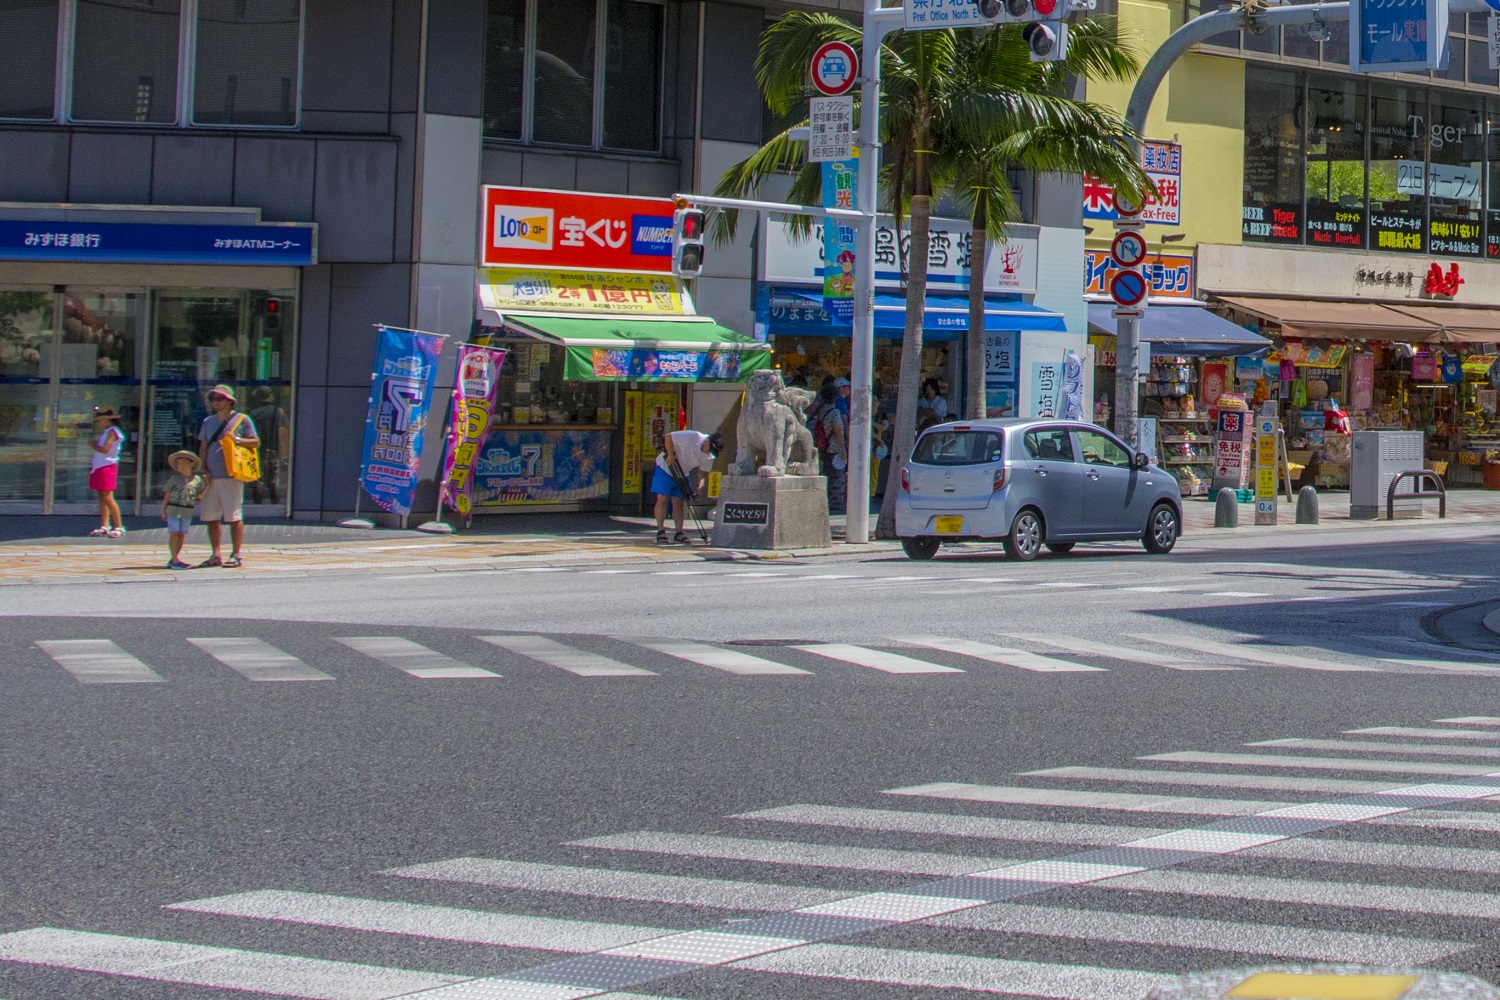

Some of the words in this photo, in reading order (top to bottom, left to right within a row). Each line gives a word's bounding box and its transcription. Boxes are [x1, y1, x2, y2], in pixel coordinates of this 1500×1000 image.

[913, 11, 927, 22] Pref.
[930, 10, 949, 21] Office
[952, 9, 969, 19] North
[1367, 19, 1426, 44] モール実施
[813, 112, 850, 122] 許可車を除く
[1407, 114, 1466, 147] Tger
[1398, 165, 1423, 189] 21日
[1429, 166, 1478, 198] オープン
[1143, 208, 1177, 221] ax-Free
[1243, 207, 1264, 221] BEER
[1273, 209, 1296, 223] Tiger
[1335, 212, 1361, 222] ミッドナイト
[500, 215, 528, 238] LOTO
[1250, 222, 1271, 236] BEEF
[1308, 221, 1322, 230] 食べる
[1371, 215, 1422, 230] ビールとステーキが
[559, 216, 627, 249] 宝くじ
[1314, 231, 1331, 243] Music
[1335, 232, 1360, 245] Beerhall
[24, 233, 101, 248] みずほ銀行
[214, 238, 301, 249] みずほATMコーナー
[1378, 231, 1421, 249] 那覇最大級
[586, 274, 644, 284] 年末ジャンボ
[555, 285, 581, 300] 2等
[581, 283, 653, 304] 1億円
[659, 361, 698, 372] キャンペーン
[1263, 423, 1271, 431] 39
[1219, 441, 1241, 453] 免税
[1259, 502, 1273, 512] 0.4
